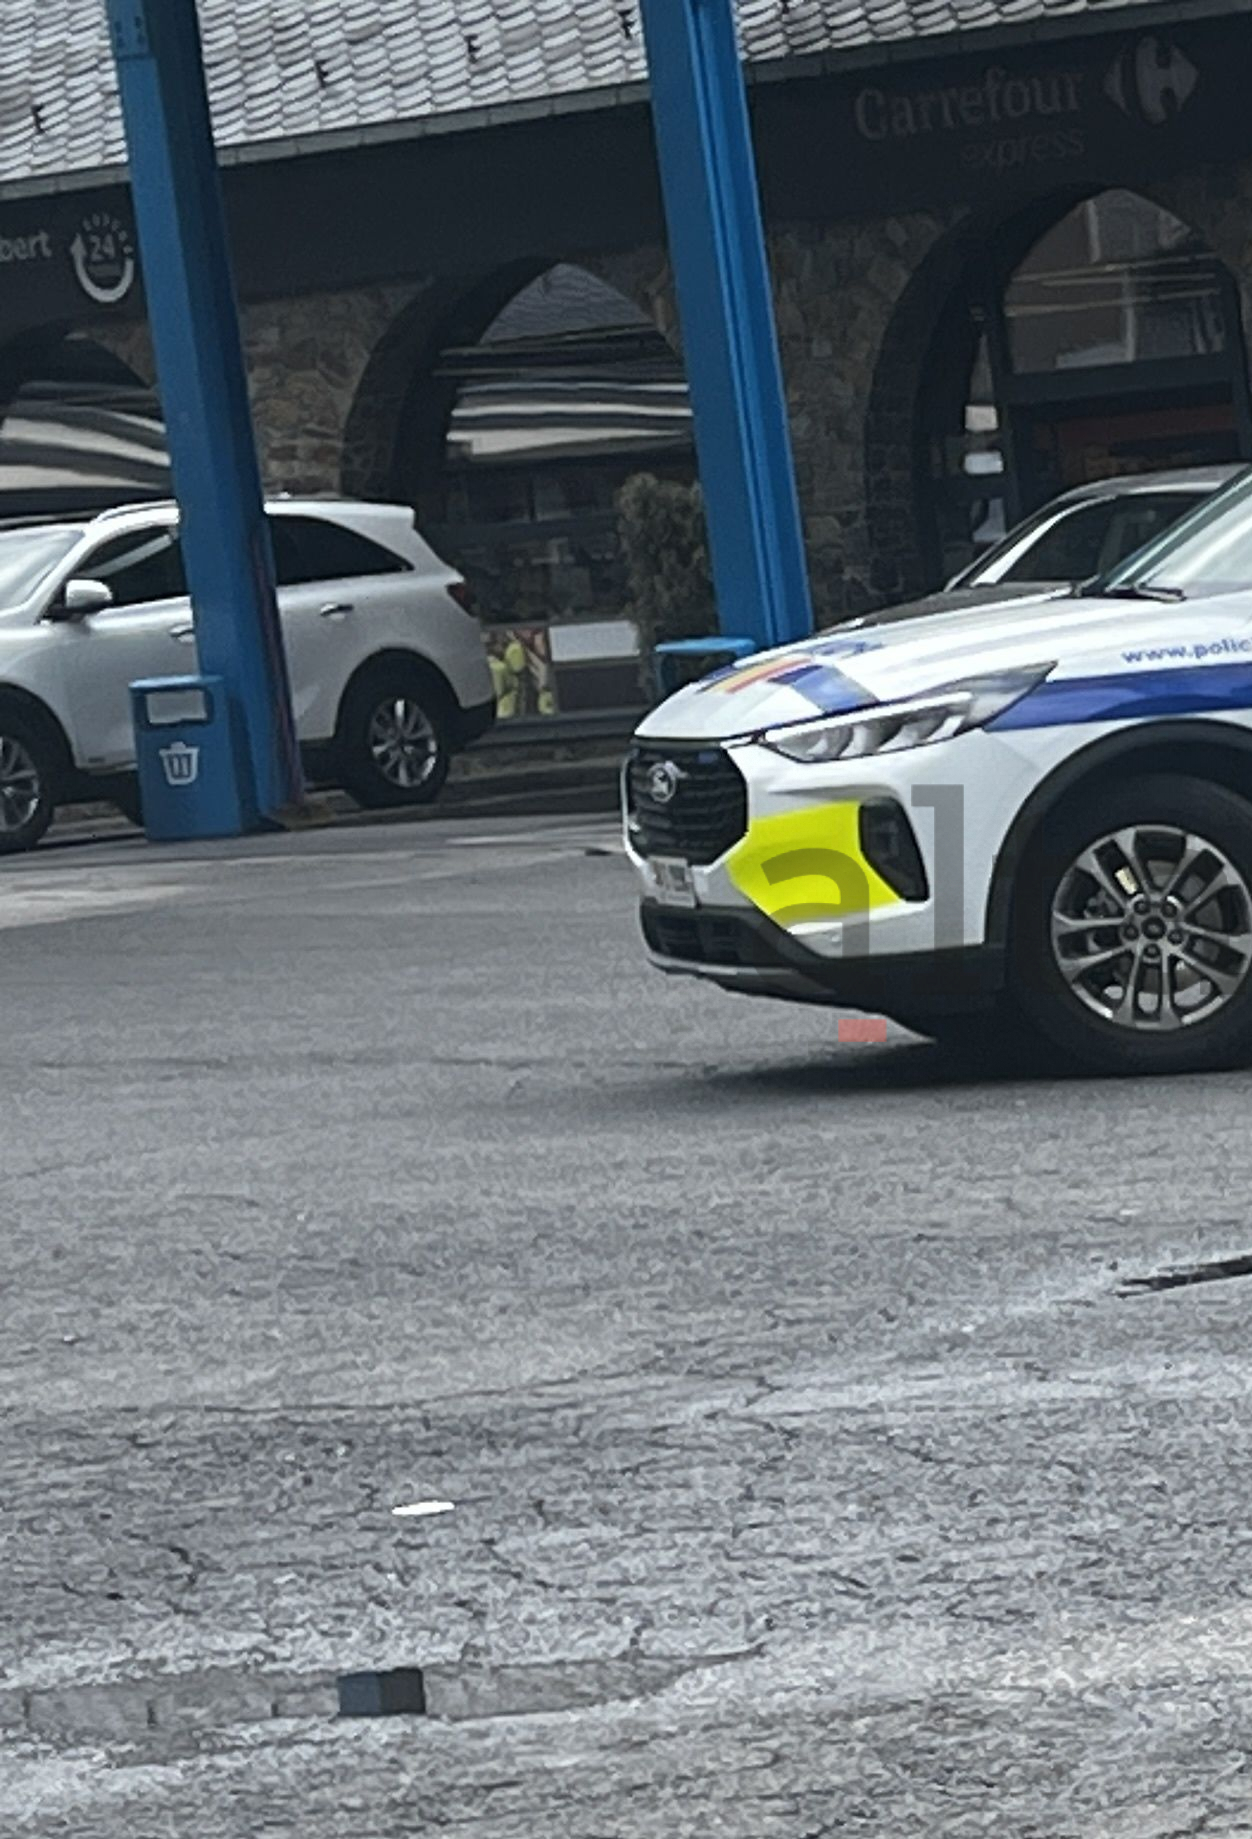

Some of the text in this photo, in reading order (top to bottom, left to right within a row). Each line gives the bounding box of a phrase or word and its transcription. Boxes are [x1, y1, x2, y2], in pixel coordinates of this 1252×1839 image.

[855, 65, 1084, 140] Carrefour
[961, 127, 1086, 171] express
[88, 233, 116, 262] 24
